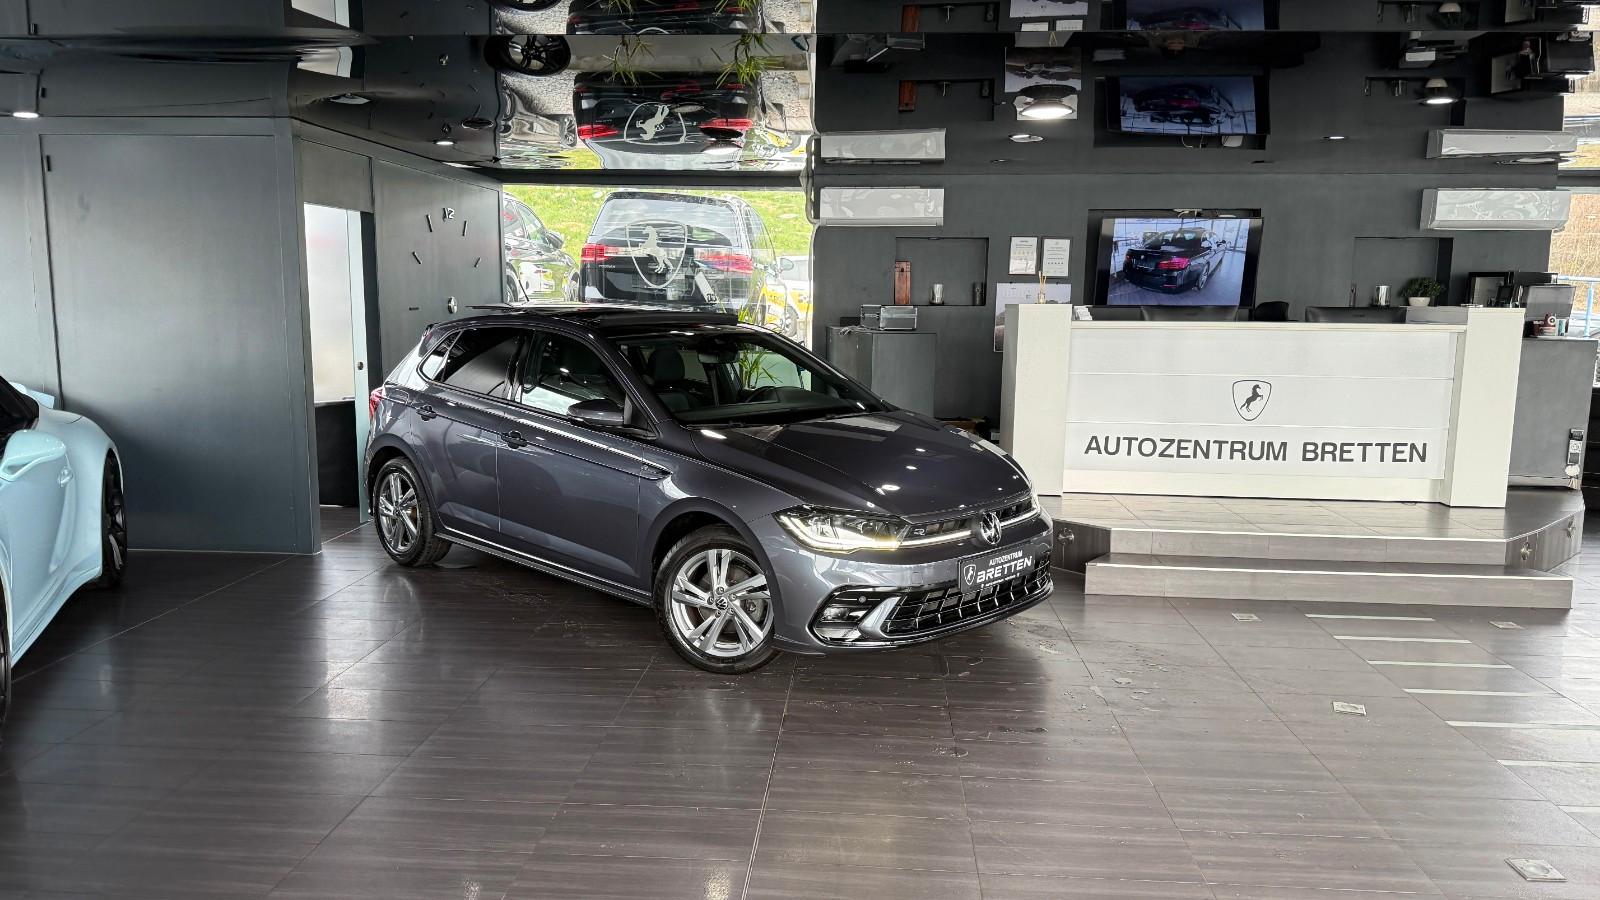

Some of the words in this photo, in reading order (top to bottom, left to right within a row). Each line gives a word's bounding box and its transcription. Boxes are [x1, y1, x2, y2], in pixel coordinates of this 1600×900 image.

[442, 207, 455, 220] 12
[1084, 435, 1288, 462] AUTOZENTRUM
[1301, 441, 1427, 463] BRETTEN
[976, 556, 1033, 583] BRETTEN
[988, 550, 1023, 567] AUTOZENTRUM
